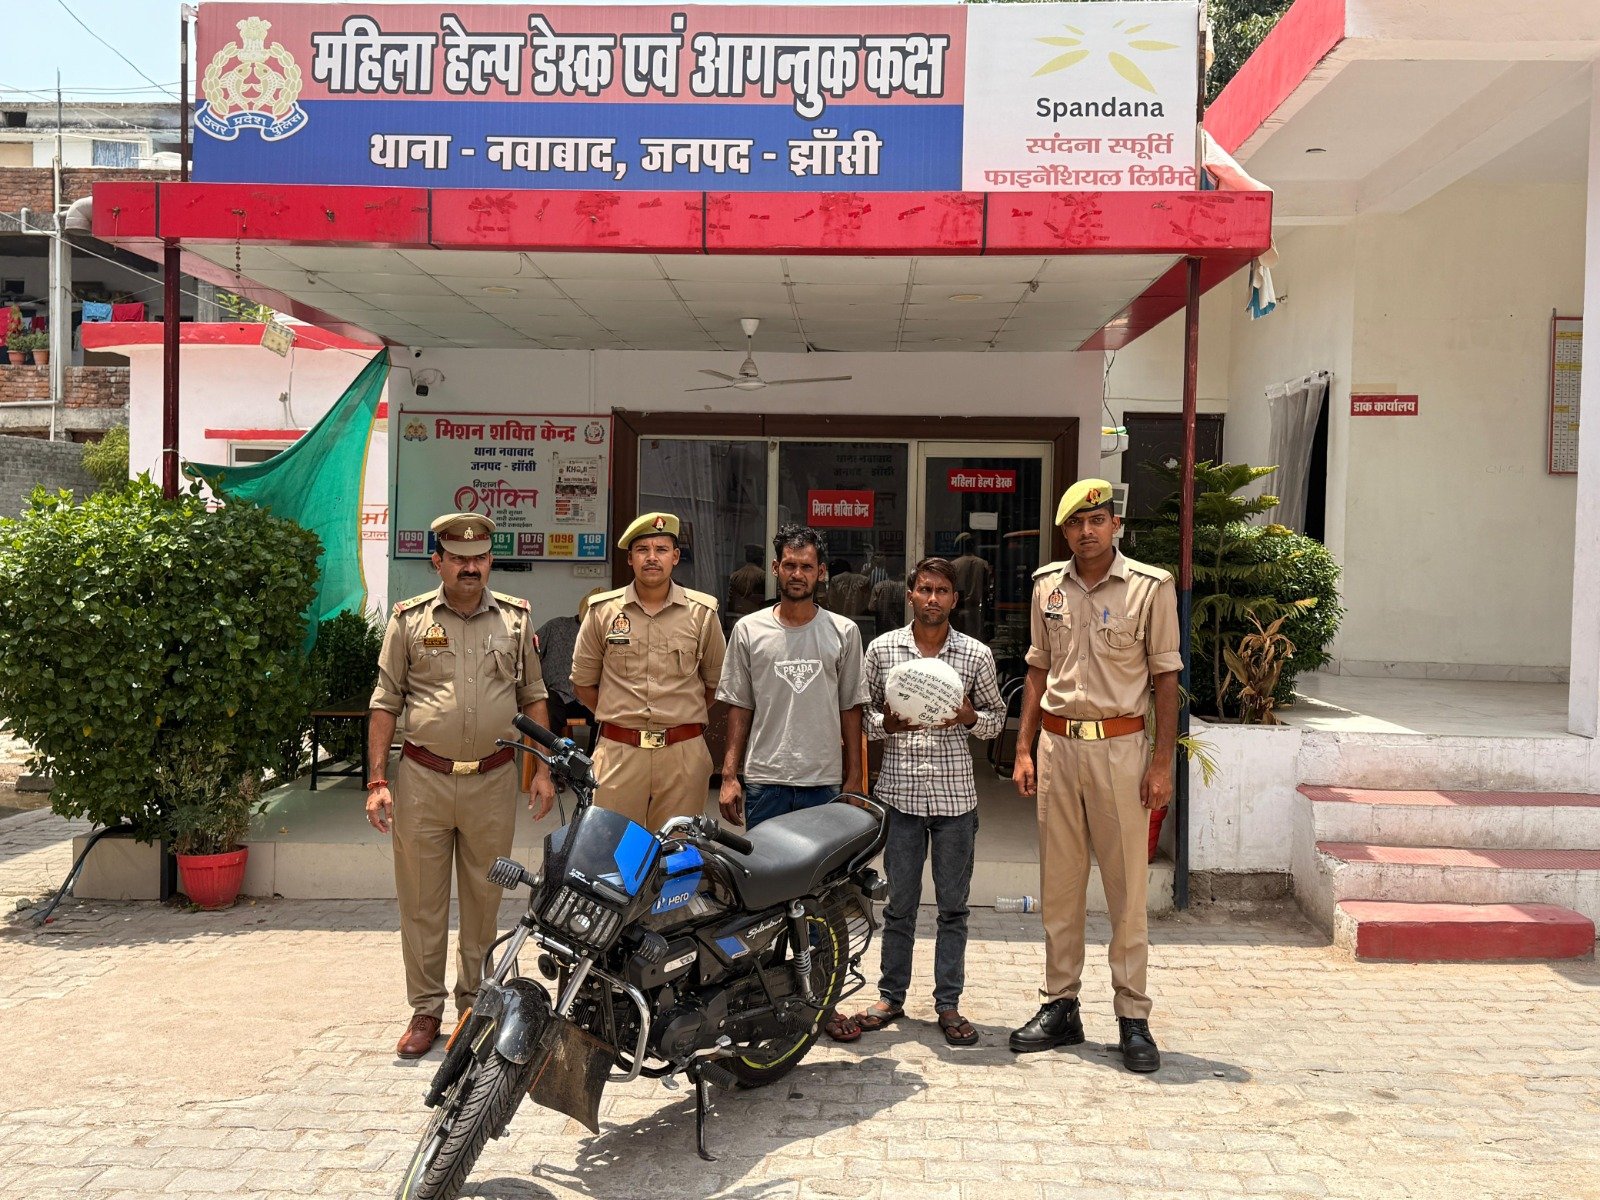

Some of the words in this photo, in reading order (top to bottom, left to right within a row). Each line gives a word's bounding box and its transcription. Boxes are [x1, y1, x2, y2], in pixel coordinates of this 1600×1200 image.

[312, 14, 438, 94] महिला
[441, 13, 527, 95] हेल्प
[529, 13, 617, 95] डेस्क
[620, 12, 687, 97] एवं
[690, 31, 863, 121] आगन्तुक
[863, 32, 950, 98] कक्ष
[1036, 97, 1164, 123] Spandana
[202, 115, 228, 135] उत्तर
[232, 113, 267, 126] प्रदेश
[271, 113, 302, 136] पुलिस
[1026, 132, 1102, 154] स्पंदना
[1108, 133, 1174, 160] स्फूर्ति
[370, 134, 452, 170] थाना
[486, 136, 628, 181] नवाबाद,
[639, 137, 754, 174] जनपद
[1128, 165, 1196, 187] लिमिटे
[1353, 401, 1372, 413] डाक
[1374, 399, 1415, 413] कार्यालय
[435, 418, 485, 440] मिशन
[490, 420, 537, 442] शक्ति
[541, 420, 577, 442] केन्द्र
[474, 447, 497, 457] थाना
[499, 447, 535, 457] नवाबाद
[470, 461, 502, 471] जनपद
[951, 474, 976, 488] महिला
[977, 474, 994, 488] हेल्प
[812, 499, 832, 517] मिशन
[834, 499, 853, 517] शक्ति
[854, 499, 869, 518] केन्द्र
[400, 532, 423, 541] 1090
[493, 534, 511, 543] 181
[520, 534, 543, 543] 1076
[549, 534, 574, 544] 1098
[583, 534, 602, 544] 108
[783, 664, 814, 675] PRADA
[668, 892, 689, 906] Hero
